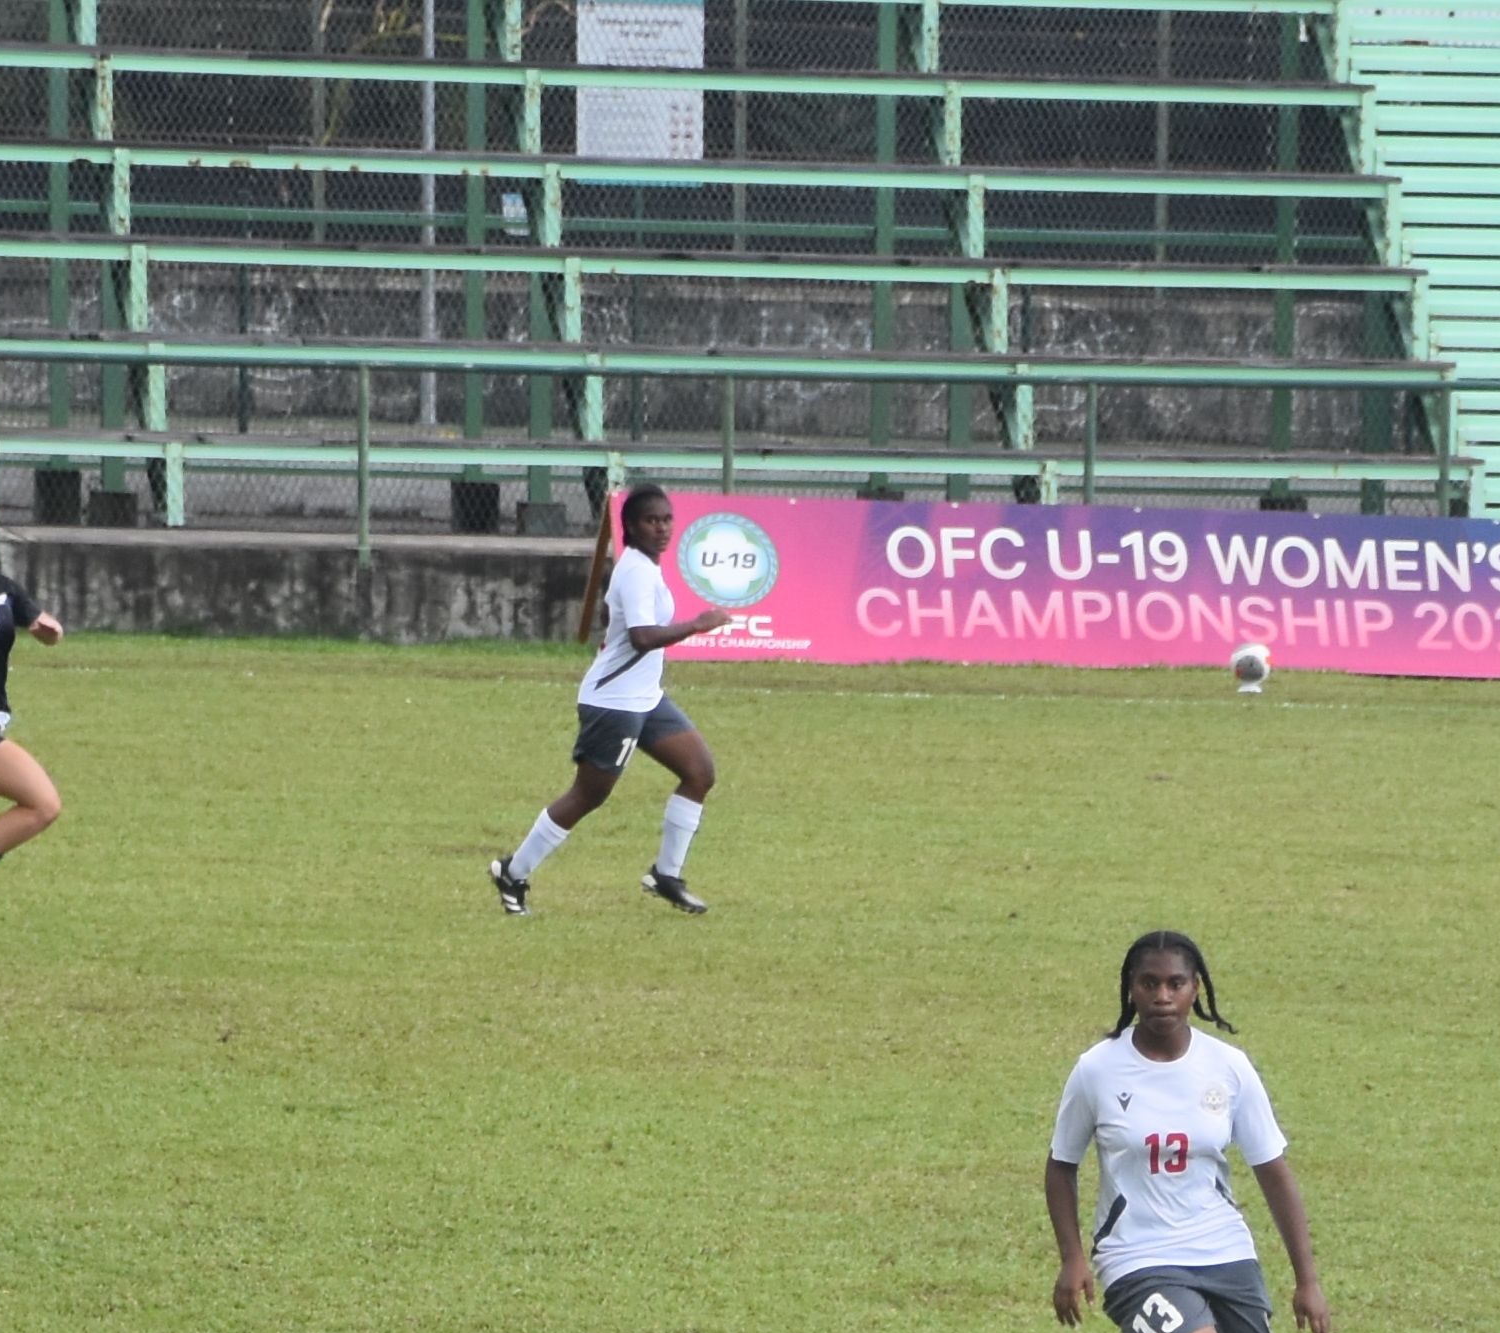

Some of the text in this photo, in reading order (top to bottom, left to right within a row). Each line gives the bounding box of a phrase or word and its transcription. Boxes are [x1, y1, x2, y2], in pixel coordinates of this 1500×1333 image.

[700, 550, 758, 570] U-19
[885, 525, 1027, 580] OFC
[1047, 528, 1188, 583] U-19
[856, 586, 1394, 649] CHAMPIONSHIP
[718, 637, 812, 650] CHAMPIONSHIP
[1144, 1132, 1190, 1175] 13
